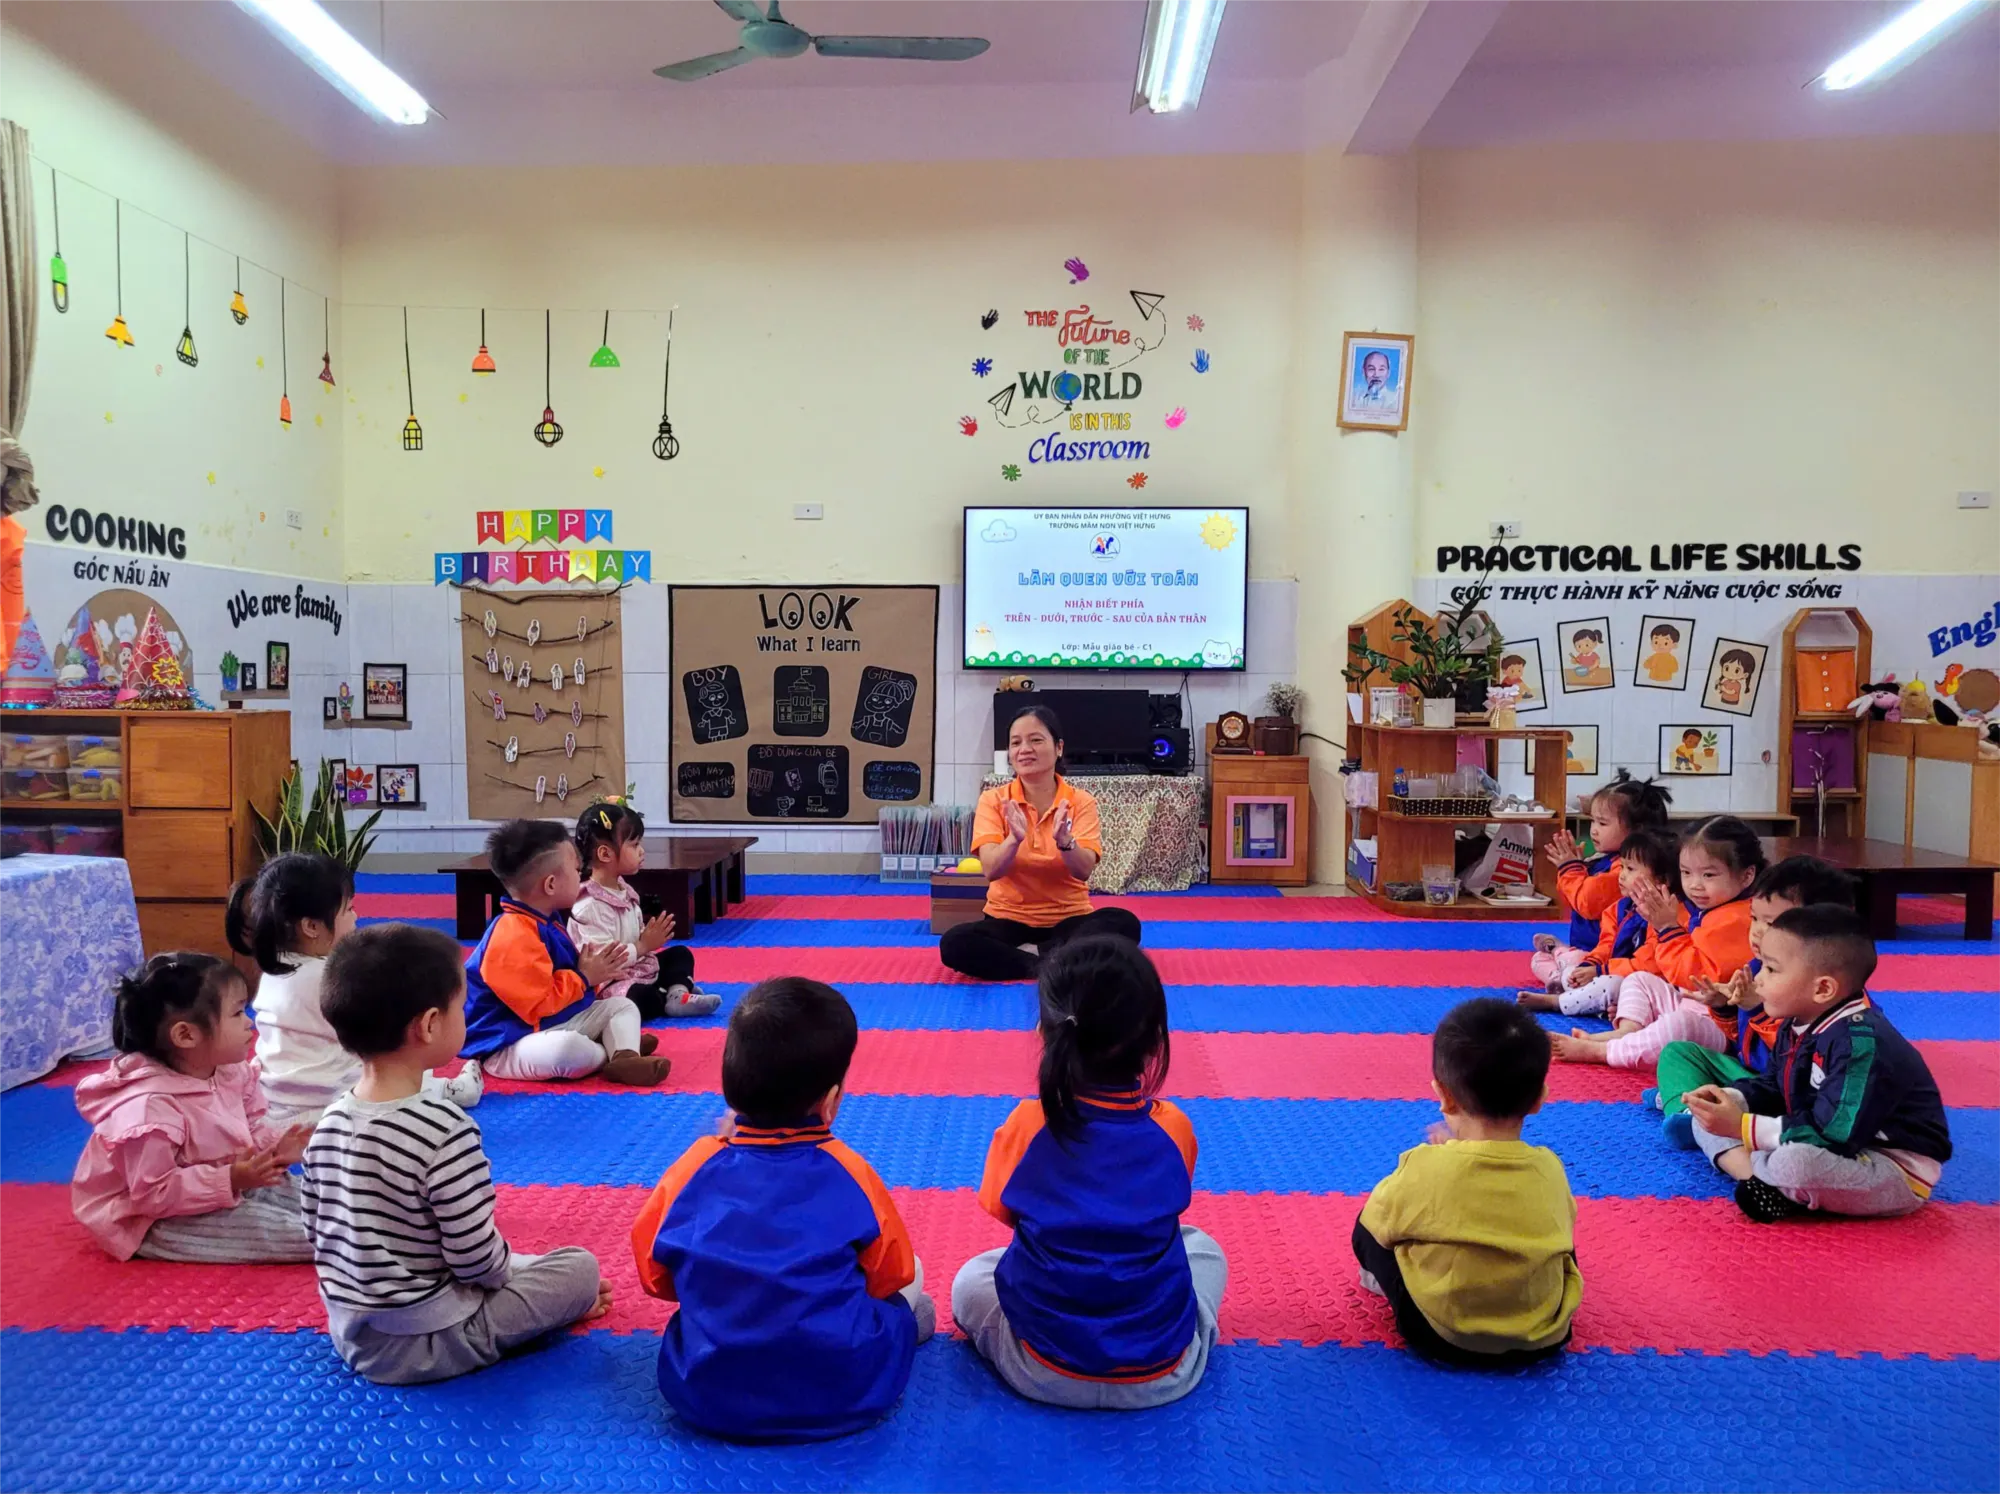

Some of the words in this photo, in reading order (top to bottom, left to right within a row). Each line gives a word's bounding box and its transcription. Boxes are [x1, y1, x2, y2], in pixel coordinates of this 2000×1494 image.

[1024, 310, 1059, 327] THE
[1058, 304, 1131, 348] Future
[1063, 348, 1081, 365] OF
[1083, 348, 1110, 365] THE
[1018, 370, 1142, 404] WORLD
[1069, 413, 1083, 431] IS
[1085, 413, 1099, 431] IN
[1101, 413, 1131, 431] THIS
[1028, 432, 1150, 463] Classroom
[46, 504, 187, 560] COOKING
[483, 513, 606, 534] HAPPY
[441, 554, 644, 575] BIRTHDAY
[1437, 545, 1642, 572] PRACTICAL
[1650, 543, 1728, 571] LIFE
[1736, 543, 1861, 571] SKILLS
[73, 555, 109, 582] GÓC
[112, 559, 146, 586] NẤU
[147, 564, 171, 588] ĂN
[1059, 572, 1108, 587] QUEN
[1450, 580, 1493, 602] GÓC
[1500, 584, 1559, 604] THỰC
[1562, 580, 1624, 600] HÀNH
[1627, 579, 1659, 600] KỸ
[1663, 580, 1720, 599] NĂNG
[1725, 580, 1780, 602] CUỘC
[1785, 577, 1842, 599] SỐNG
[227, 589, 259, 629] We
[261, 594, 292, 616] are
[294, 584, 342, 636] family
[758, 592, 862, 632] LOOK
[1064, 598, 1093, 610] NHẬN
[1095, 597, 1119, 609] BIẾT
[1121, 598, 1145, 609] PHÍA
[1004, 613, 1031, 622] TRÊN
[1070, 612, 1103, 623] TRƯỚC
[1112, 614, 1132, 623] SAU
[1134, 612, 1154, 623] CỦA
[1156, 612, 1177, 623] BẢN
[1179, 613, 1207, 623] THÂN
[1927, 601, 2000, 658] Engl
[757, 635, 798, 652] What
[806, 636, 814, 652] I
[821, 636, 861, 652] learn
[1061, 643, 1080, 652] Lớp:
[1103, 643, 1122, 652] giáo
[1124, 643, 1135, 651] bé
[1143, 643, 1153, 651] C1
[691, 666, 728, 687] BOY
[867, 667, 898, 682] GIRL
[706, 766, 725, 776] NAY
